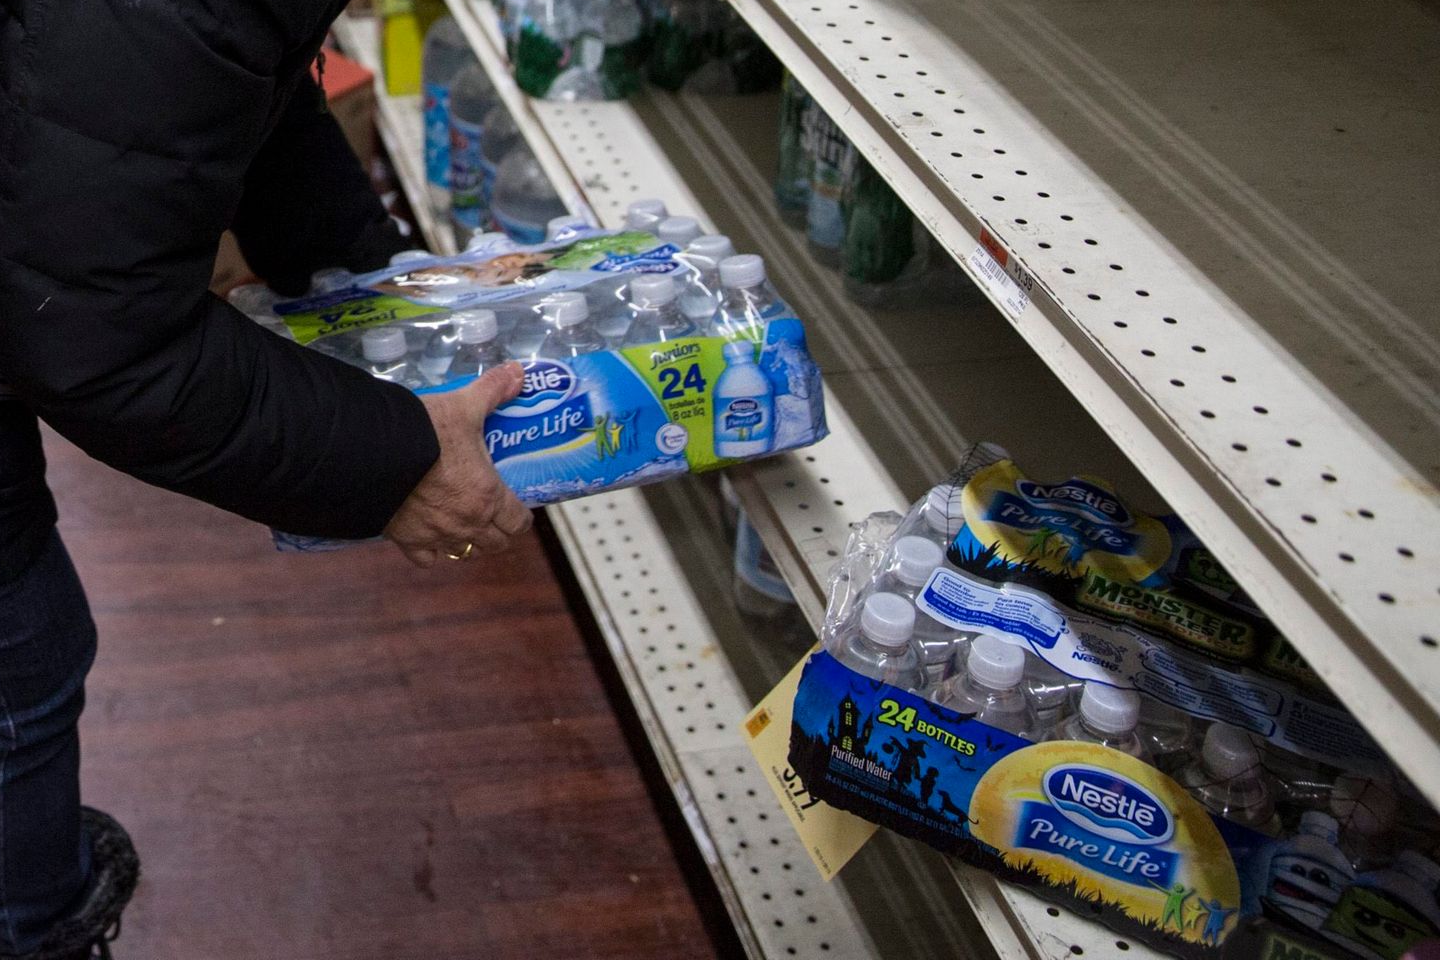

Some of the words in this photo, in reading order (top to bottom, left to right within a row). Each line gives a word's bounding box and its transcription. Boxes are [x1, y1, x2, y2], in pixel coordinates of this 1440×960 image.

[659, 363, 708, 400] 24
[486, 420, 542, 456] Pure
[543, 410, 586, 437] Life
[999, 502, 1068, 525] Pure
[1071, 516, 1125, 548] Life
[1086, 574, 1250, 646] MONSTER
[1117, 596, 1218, 637] BOTTLES
[878, 699, 917, 732] 24
[916, 720, 977, 756] BOTTLES
[831, 744, 866, 769] Purified
[865, 760, 893, 781] Water
[1030, 818, 1101, 858] Pure
[1101, 844, 1161, 878] Life
